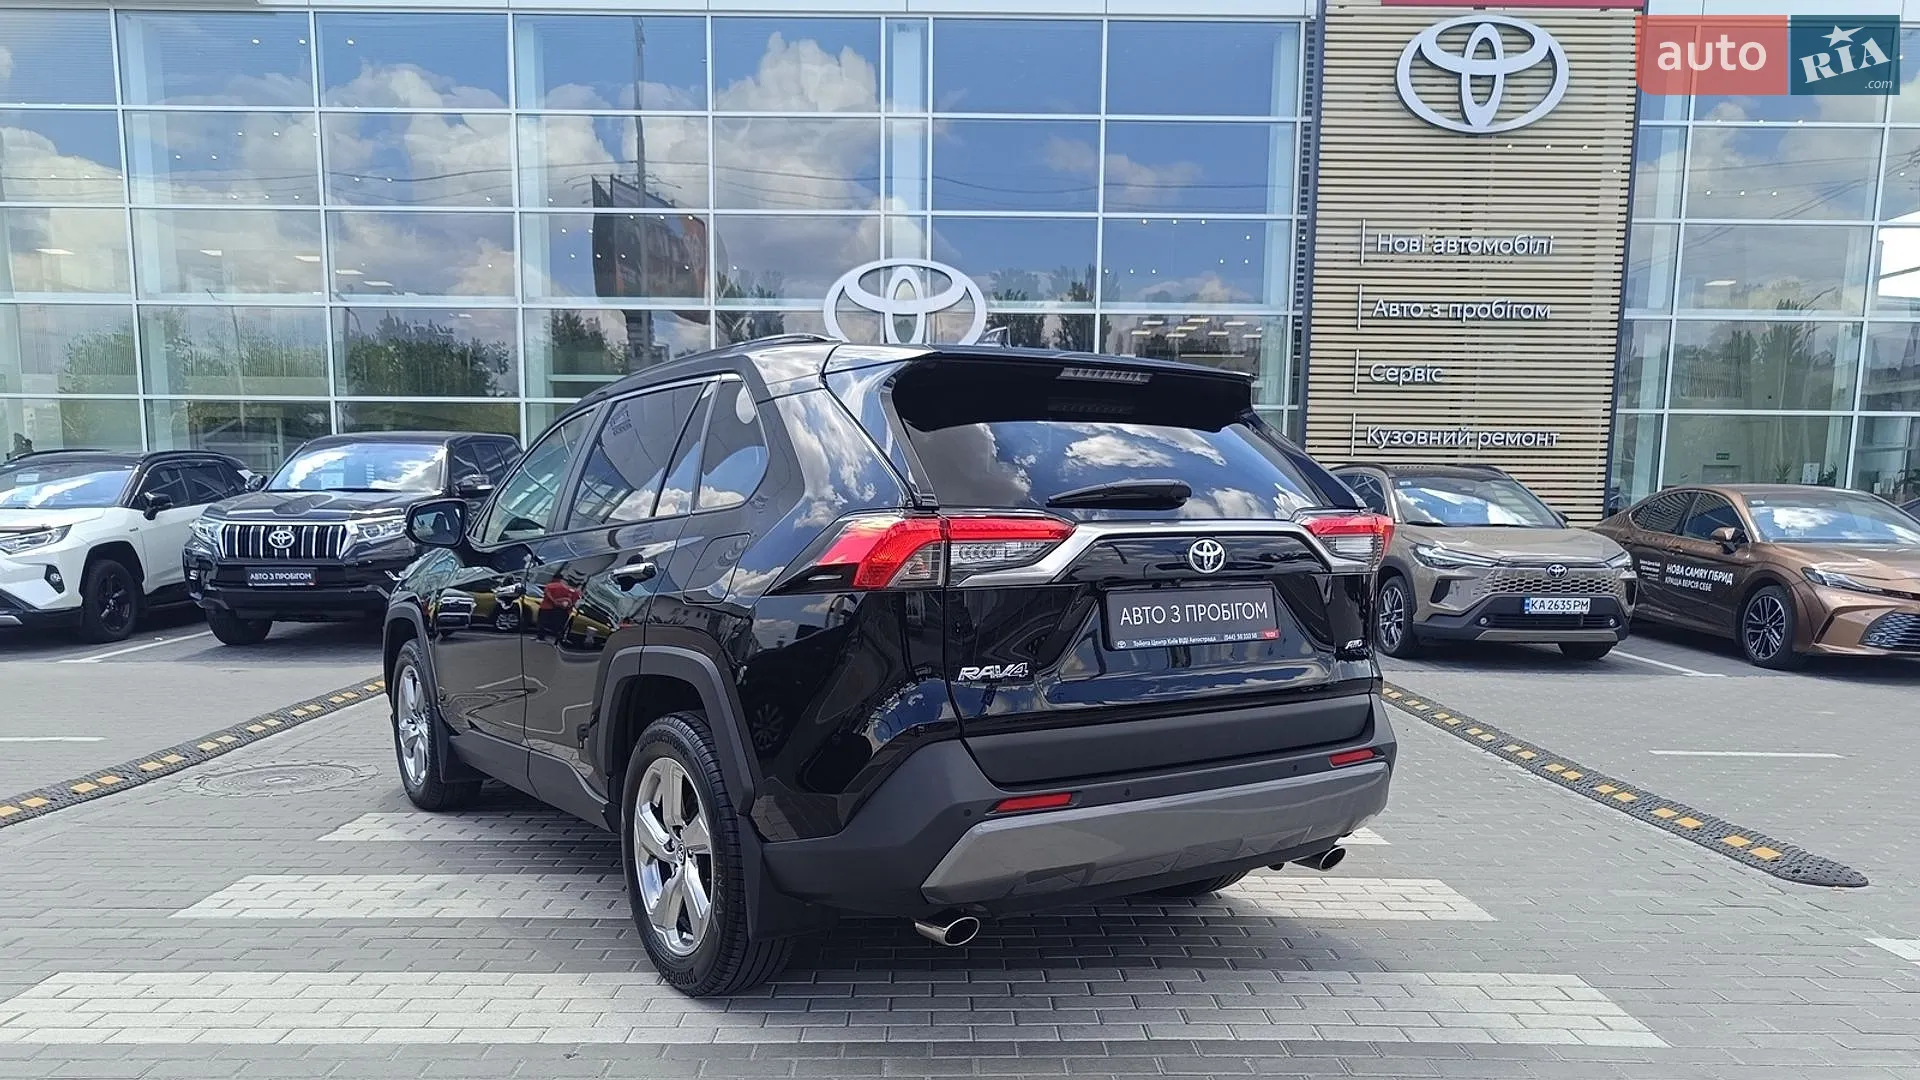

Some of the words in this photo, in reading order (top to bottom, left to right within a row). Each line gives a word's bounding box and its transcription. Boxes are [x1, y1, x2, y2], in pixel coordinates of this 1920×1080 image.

[1376, 232, 1426, 253] Нові
[1432, 233, 1554, 255] автомобілі
[1372, 298, 1424, 318] Авто
[1430, 302, 1440, 318] з
[1449, 298, 1550, 323] пробігом
[1369, 363, 1444, 387] Сервіс
[1366, 425, 1470, 449] Кузовний
[1477, 430, 1560, 451] ремонт
[250, 572, 268, 580] АВТО
[1666, 563, 1684, 575] НОВА
[1120, 605, 1167, 626] АВТО
[1170, 605, 1181, 623] З
[1185, 601, 1268, 623] ПРОБІГОМ
[957, 662, 1029, 681] RAV4
